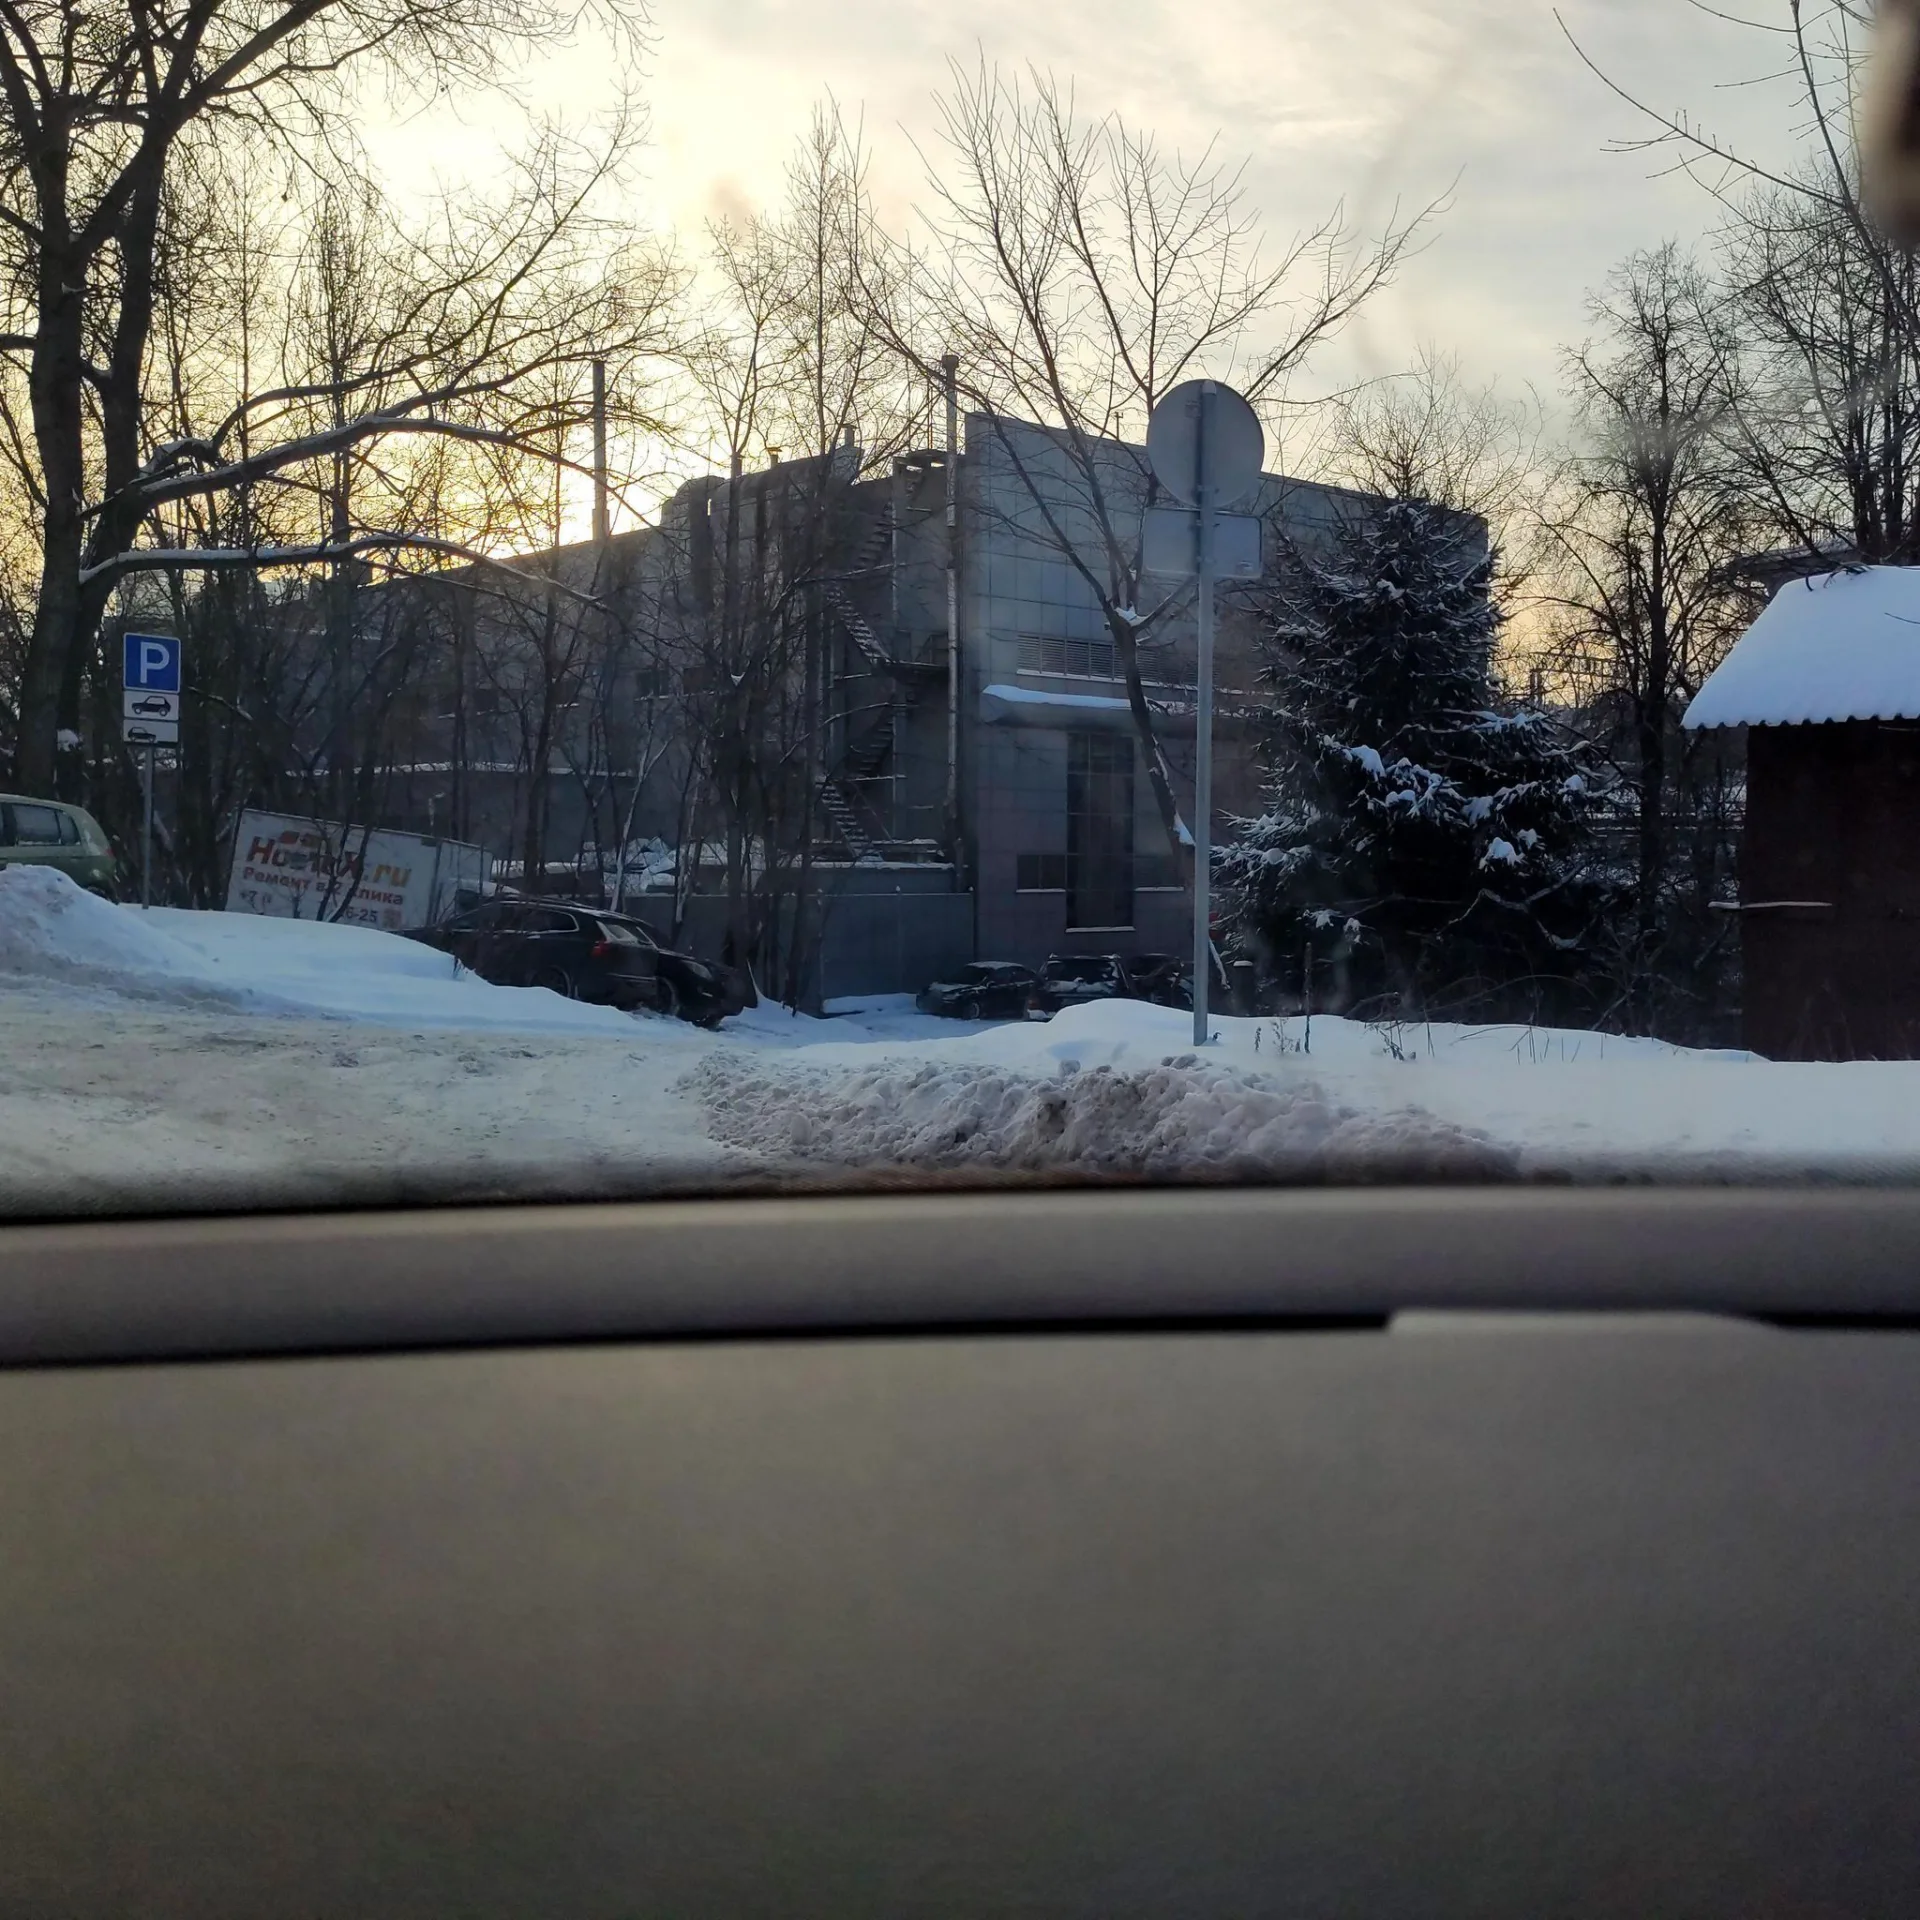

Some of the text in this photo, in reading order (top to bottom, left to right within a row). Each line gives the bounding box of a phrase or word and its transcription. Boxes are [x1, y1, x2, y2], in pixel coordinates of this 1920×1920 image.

[140, 641, 170, 684] P
[243, 866, 312, 891] Ремонт
[347, 885, 404, 905] лика
